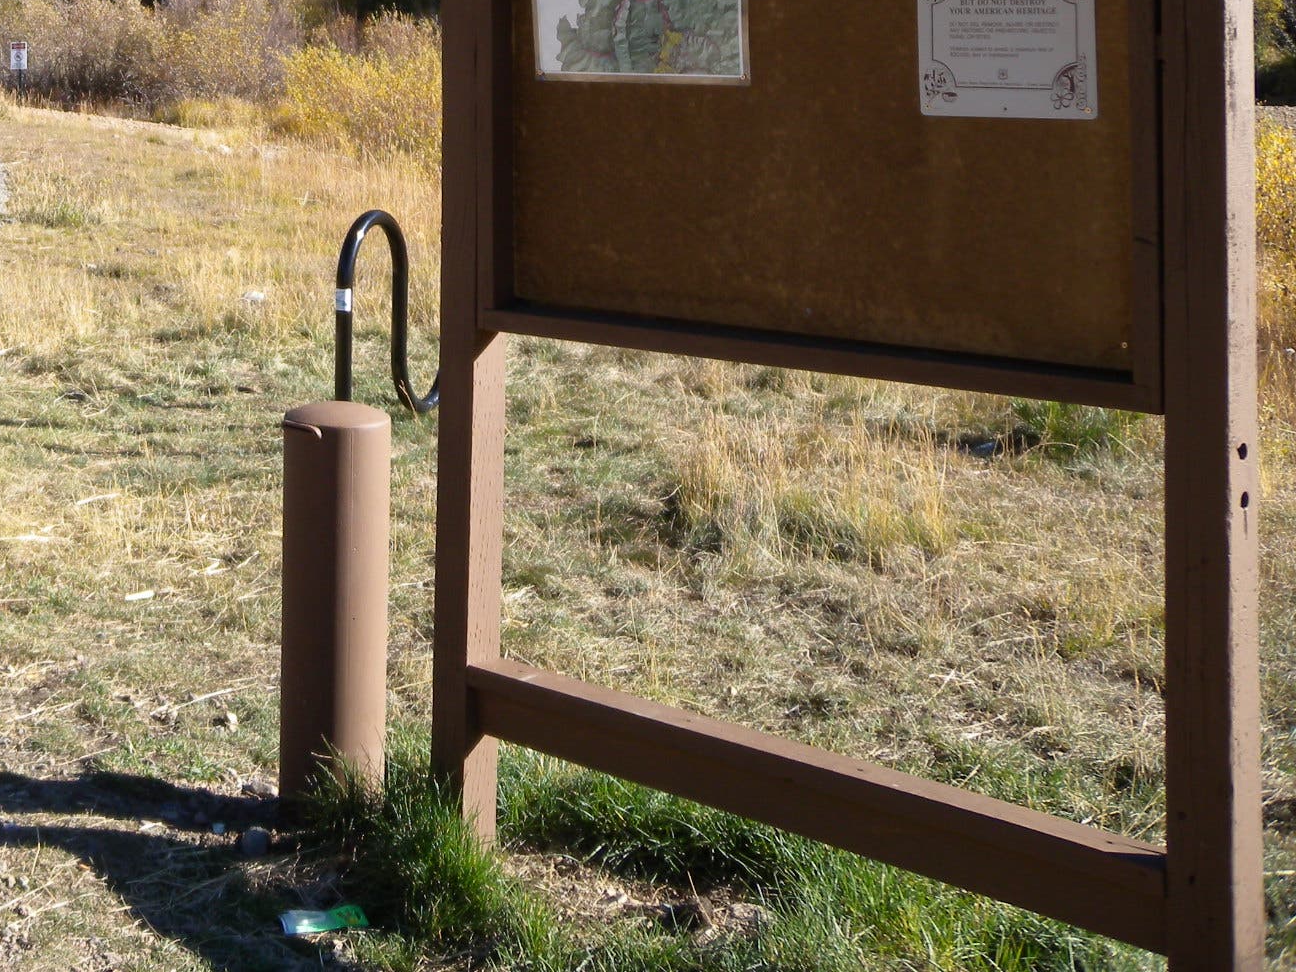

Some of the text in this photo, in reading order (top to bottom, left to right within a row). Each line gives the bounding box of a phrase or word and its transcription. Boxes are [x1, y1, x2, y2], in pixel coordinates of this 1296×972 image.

[949, 6, 1057, 15] YOUR AMERICAN HERITAGE
